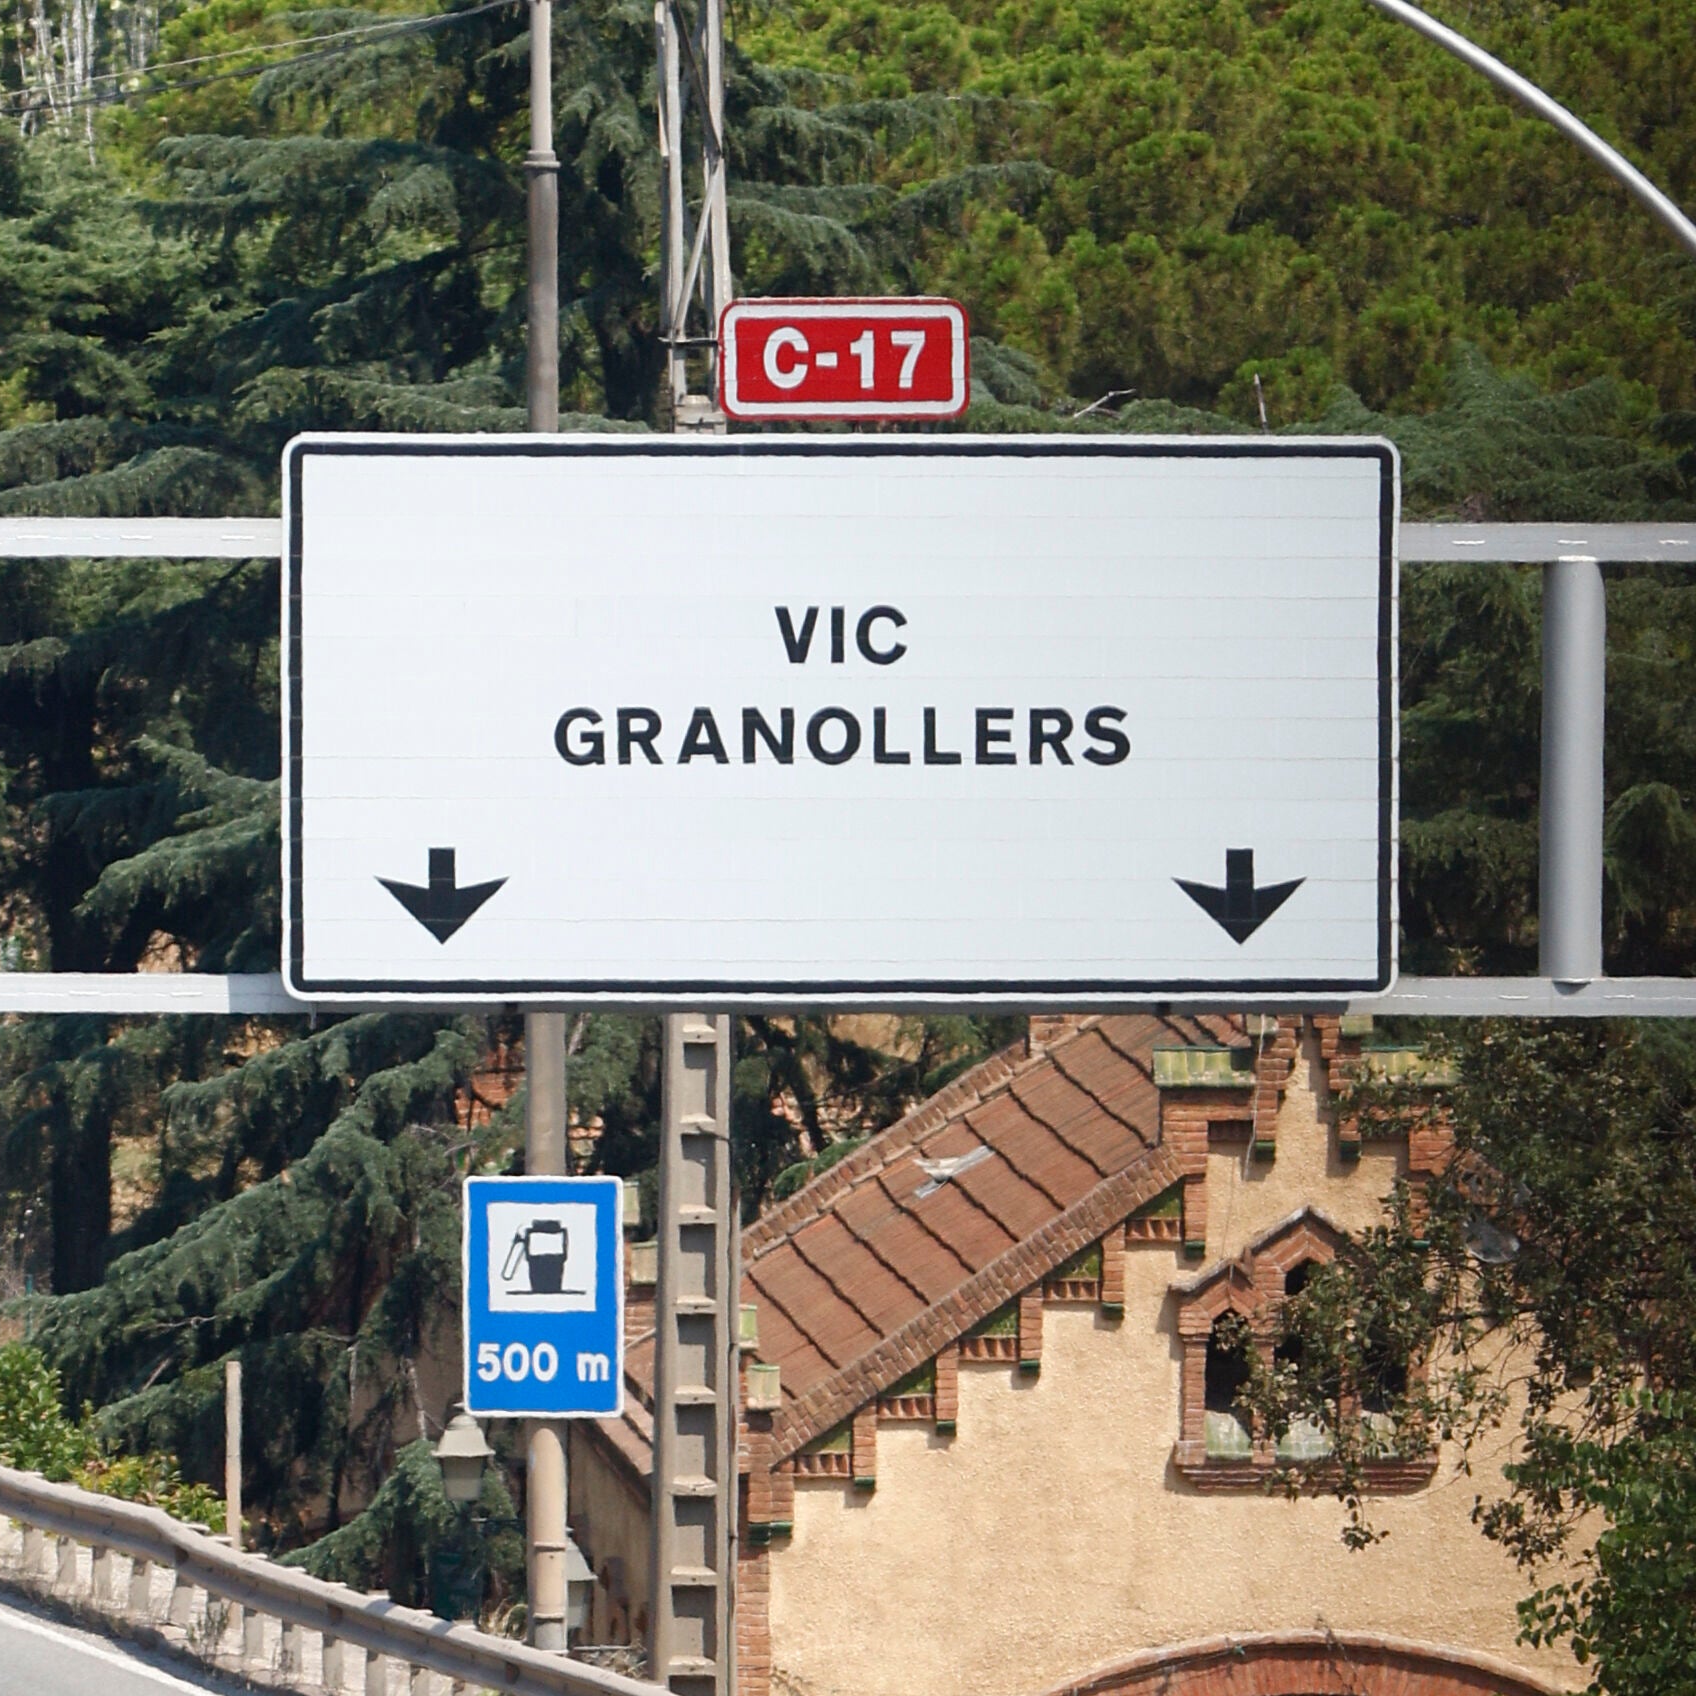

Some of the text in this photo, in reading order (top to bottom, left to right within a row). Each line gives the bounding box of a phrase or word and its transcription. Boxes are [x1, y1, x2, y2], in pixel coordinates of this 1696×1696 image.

[763, 328, 931, 390] C-17
[775, 604, 910, 667] VIC
[554, 705, 1133, 768] GRANOLLERS
[477, 1342, 610, 1382] 500 m
